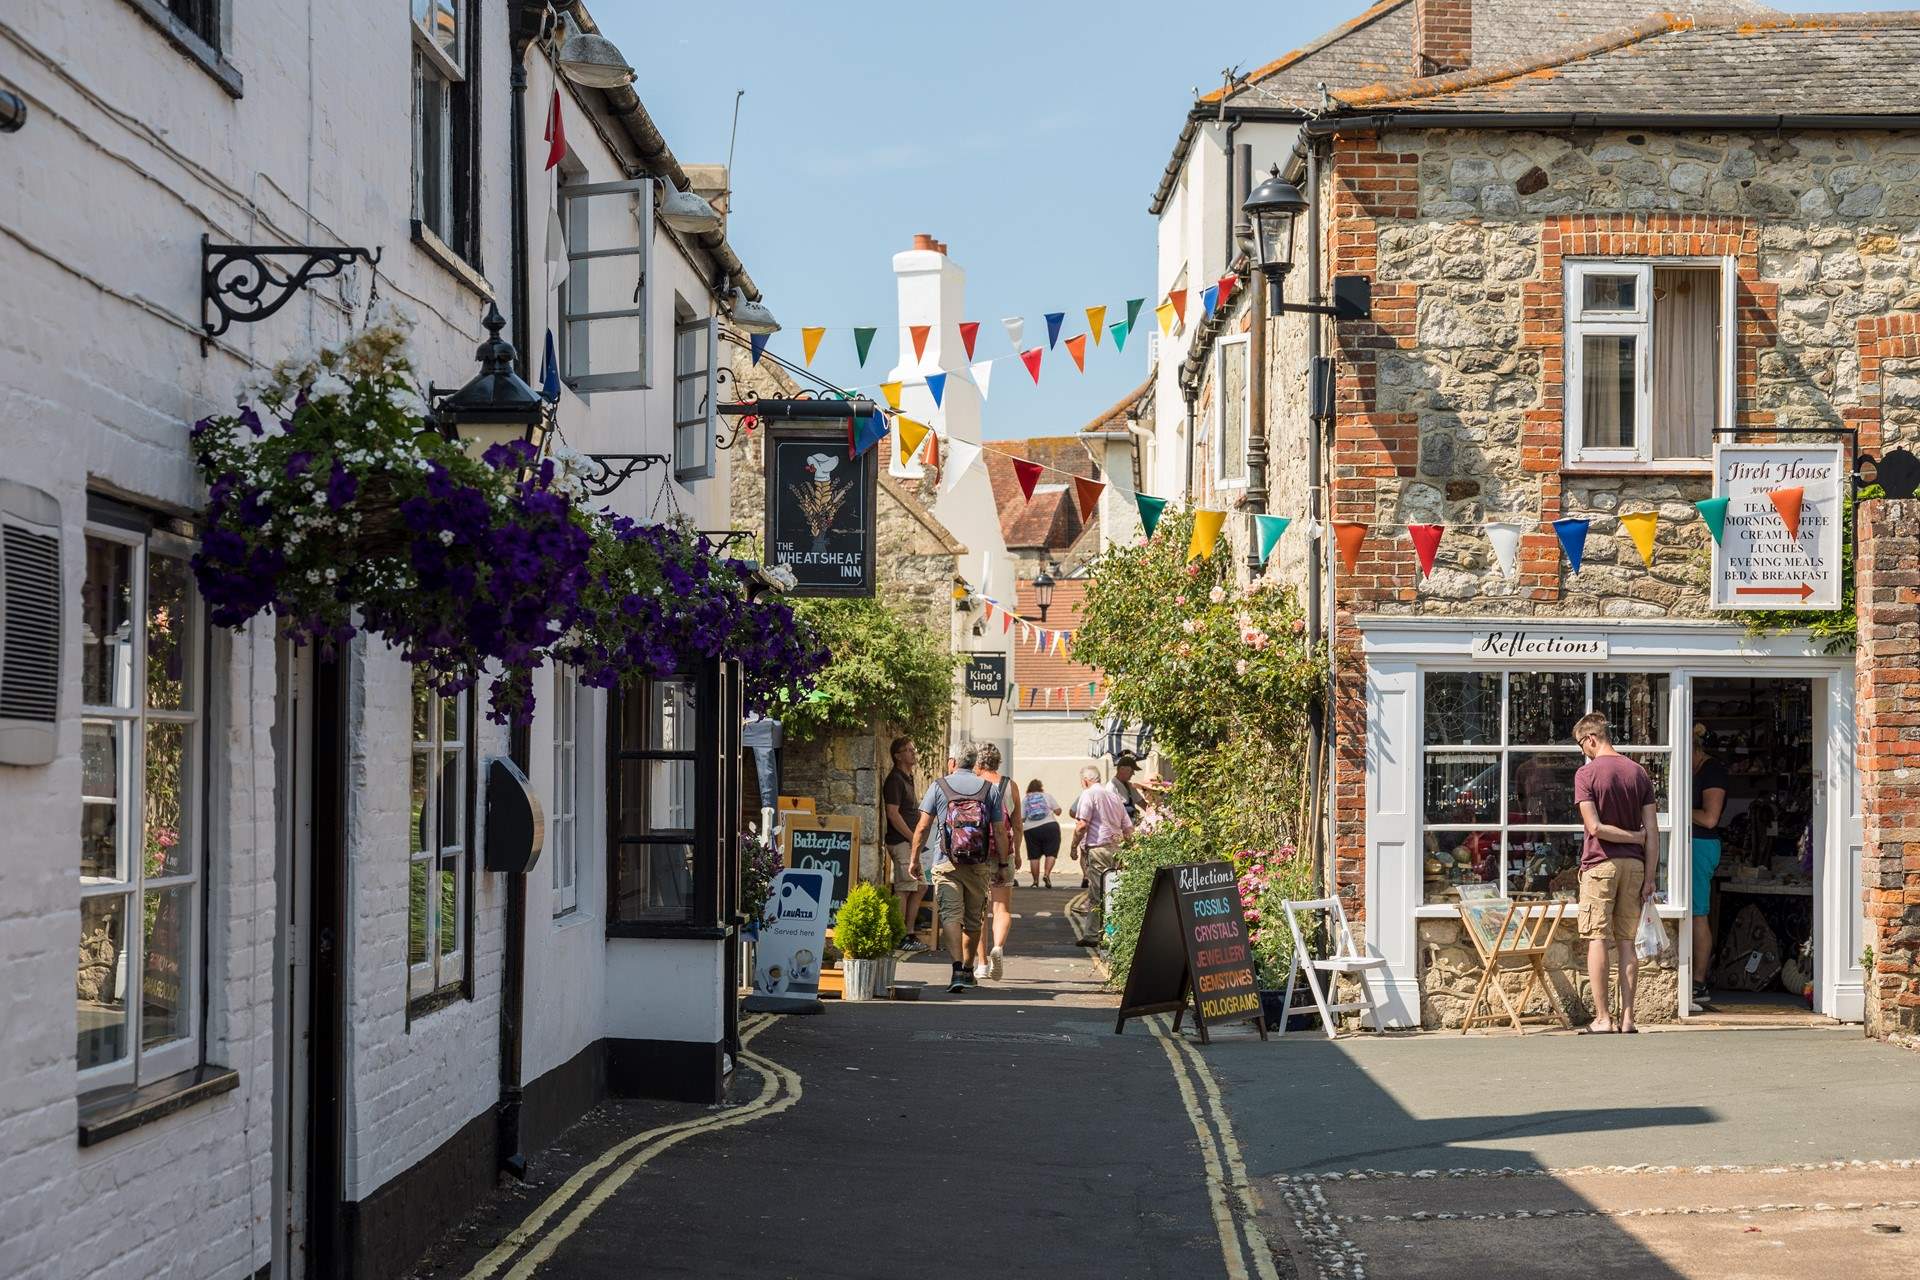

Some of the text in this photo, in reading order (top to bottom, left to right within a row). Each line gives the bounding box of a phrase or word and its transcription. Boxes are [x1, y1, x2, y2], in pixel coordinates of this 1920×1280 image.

[1725, 458, 1831, 483] Jireh House
[1744, 503, 1766, 512] TEA
[1725, 517, 1829, 526] MORNING FFEE
[1740, 530, 1814, 540] CREAM TAS
[776, 542, 794, 551] THE
[1750, 544, 1804, 553] LUNCHES
[776, 552, 862, 564] WHEATSHEAF
[1730, 557, 1824, 567] EVENING MEALS
[840, 565, 862, 577] INN
[1725, 571, 1829, 580] BED & BREAKFAST
[1482, 632, 1599, 657] Reflections
[970, 670, 1002, 682] King's
[973, 681, 998, 691] Head
[793, 832, 851, 855] Butterflies
[1179, 867, 1234, 891] Reflections
[1194, 897, 1230, 918] FOSSILS
[773, 927, 815, 937] Served here
[1194, 920, 1239, 942] CRYSTALS
[1196, 944, 1246, 968] JEWELLERY
[1199, 968, 1253, 993] GEMSTONES
[1202, 992, 1259, 1018] HOLOGRAMS
